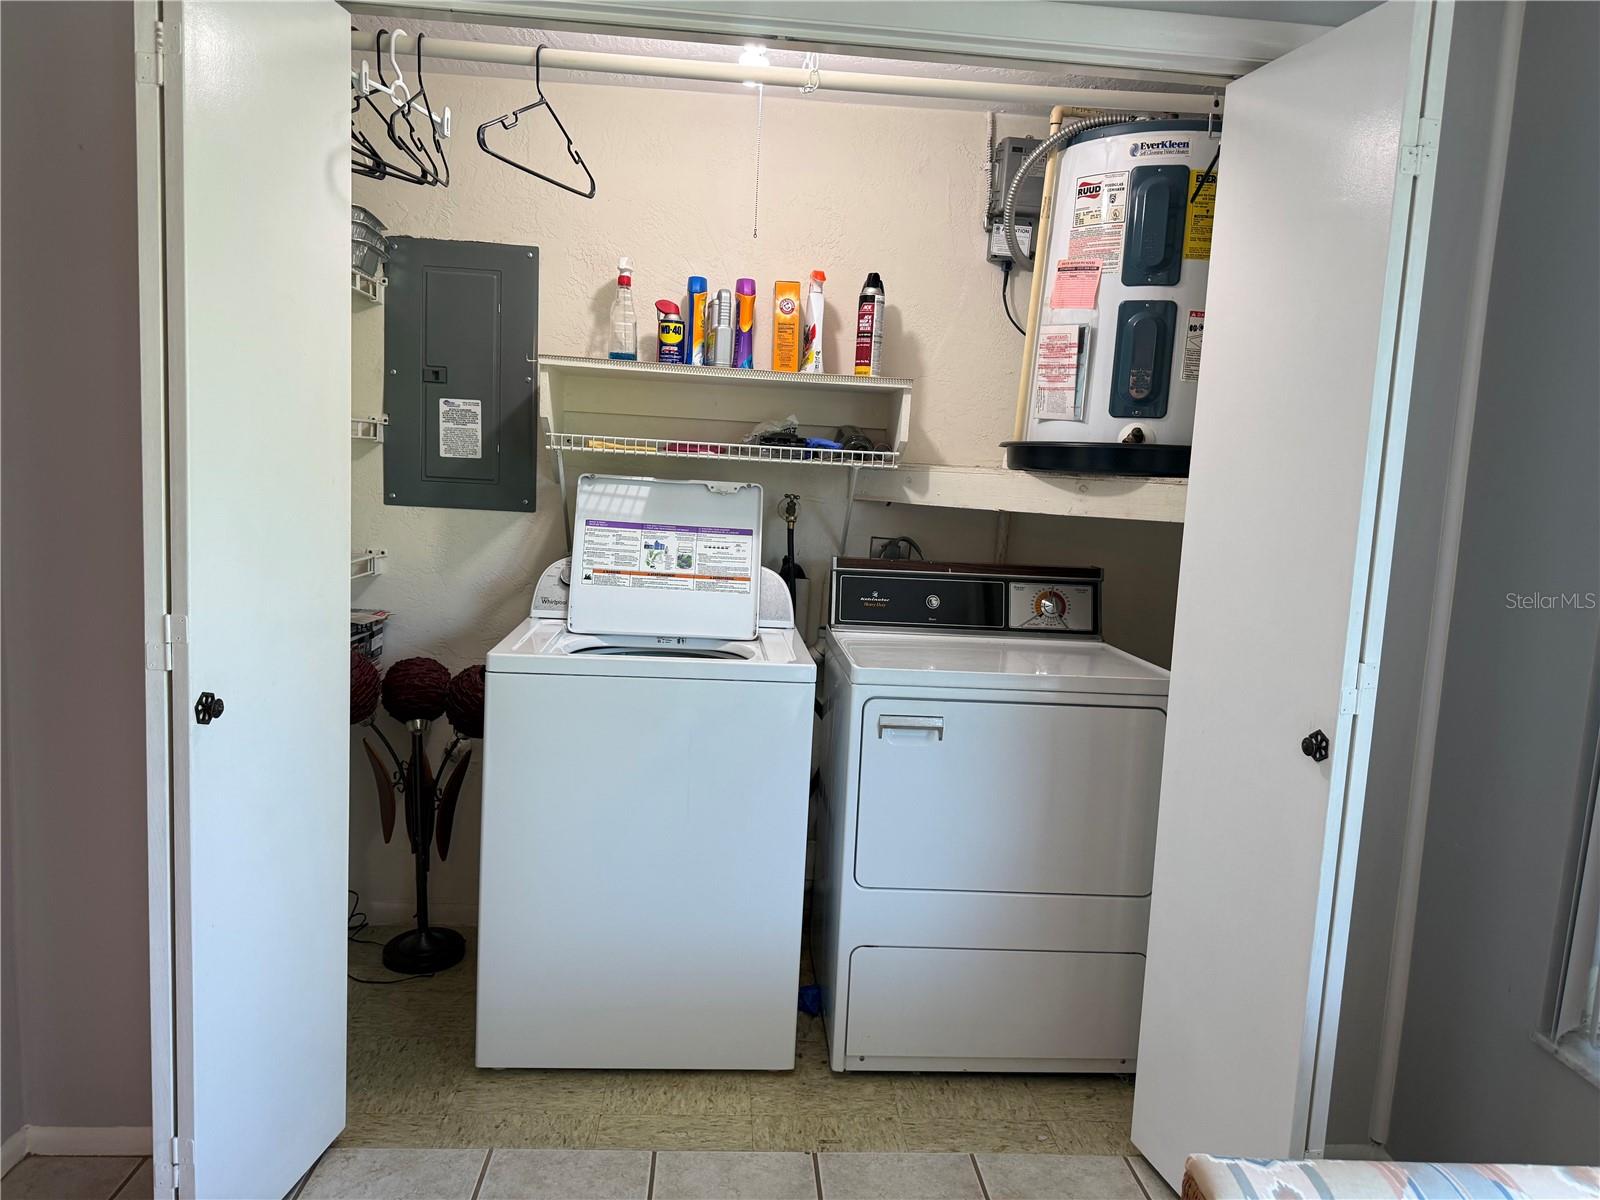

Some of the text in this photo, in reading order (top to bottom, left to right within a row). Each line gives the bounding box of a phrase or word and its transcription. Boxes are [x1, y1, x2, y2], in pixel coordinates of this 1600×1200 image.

[1140, 140, 1189, 150] EverKleen
[1077, 185, 1101, 196] RUUD
[660, 325, 682, 335] WD-40
